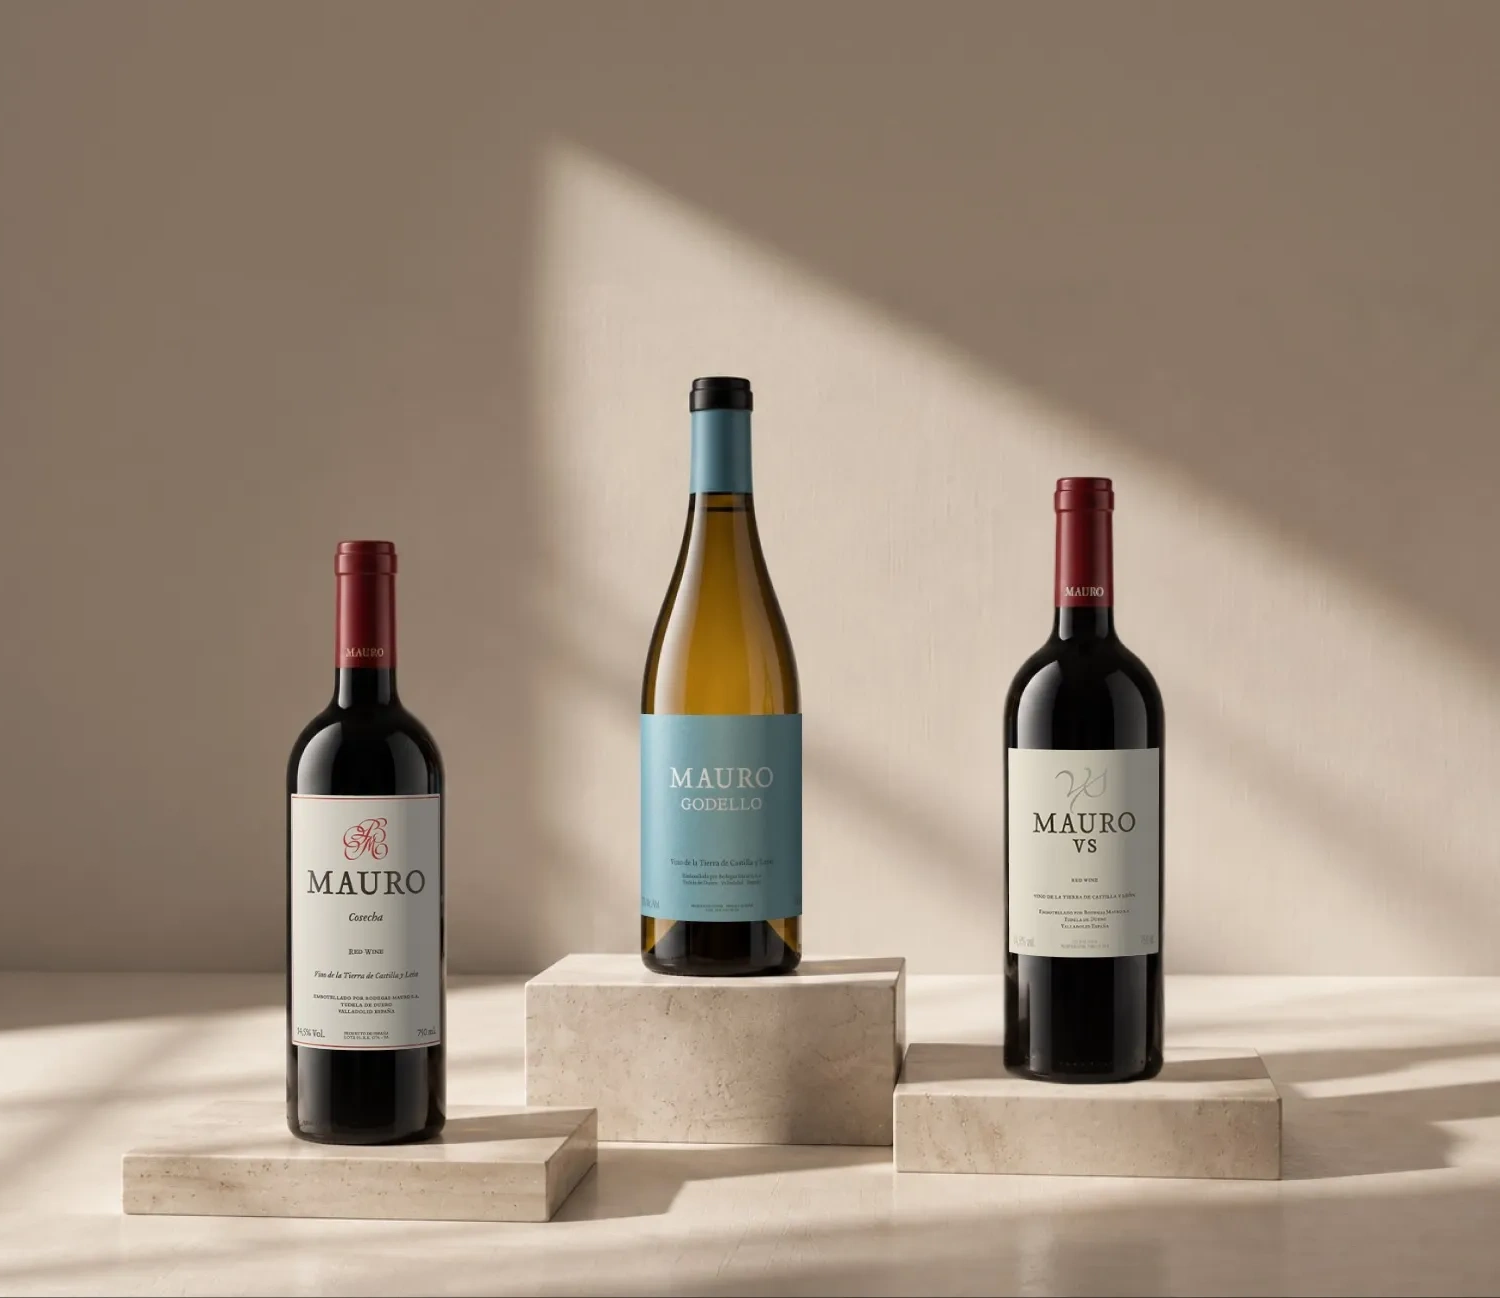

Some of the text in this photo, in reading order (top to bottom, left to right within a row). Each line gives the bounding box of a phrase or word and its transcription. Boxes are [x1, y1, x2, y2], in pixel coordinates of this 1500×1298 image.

[1064, 586, 1105, 597] MAURO
[345, 647, 384, 658] MAURO
[669, 766, 774, 789] MAURO
[680, 797, 763, 811] GODELLO
[1033, 811, 1136, 834] MAURO
[1072, 838, 1098, 853] VS
[699, 858, 720, 867] Tierra
[307, 869, 426, 895] MAURO
[348, 911, 384, 922] Cosecha
[314, 970, 327, 978] Vino
[335, 971, 342, 979] la
[343, 971, 365, 979] Tierra
[366, 971, 374, 979] de
[375, 971, 399, 979] Castilla
